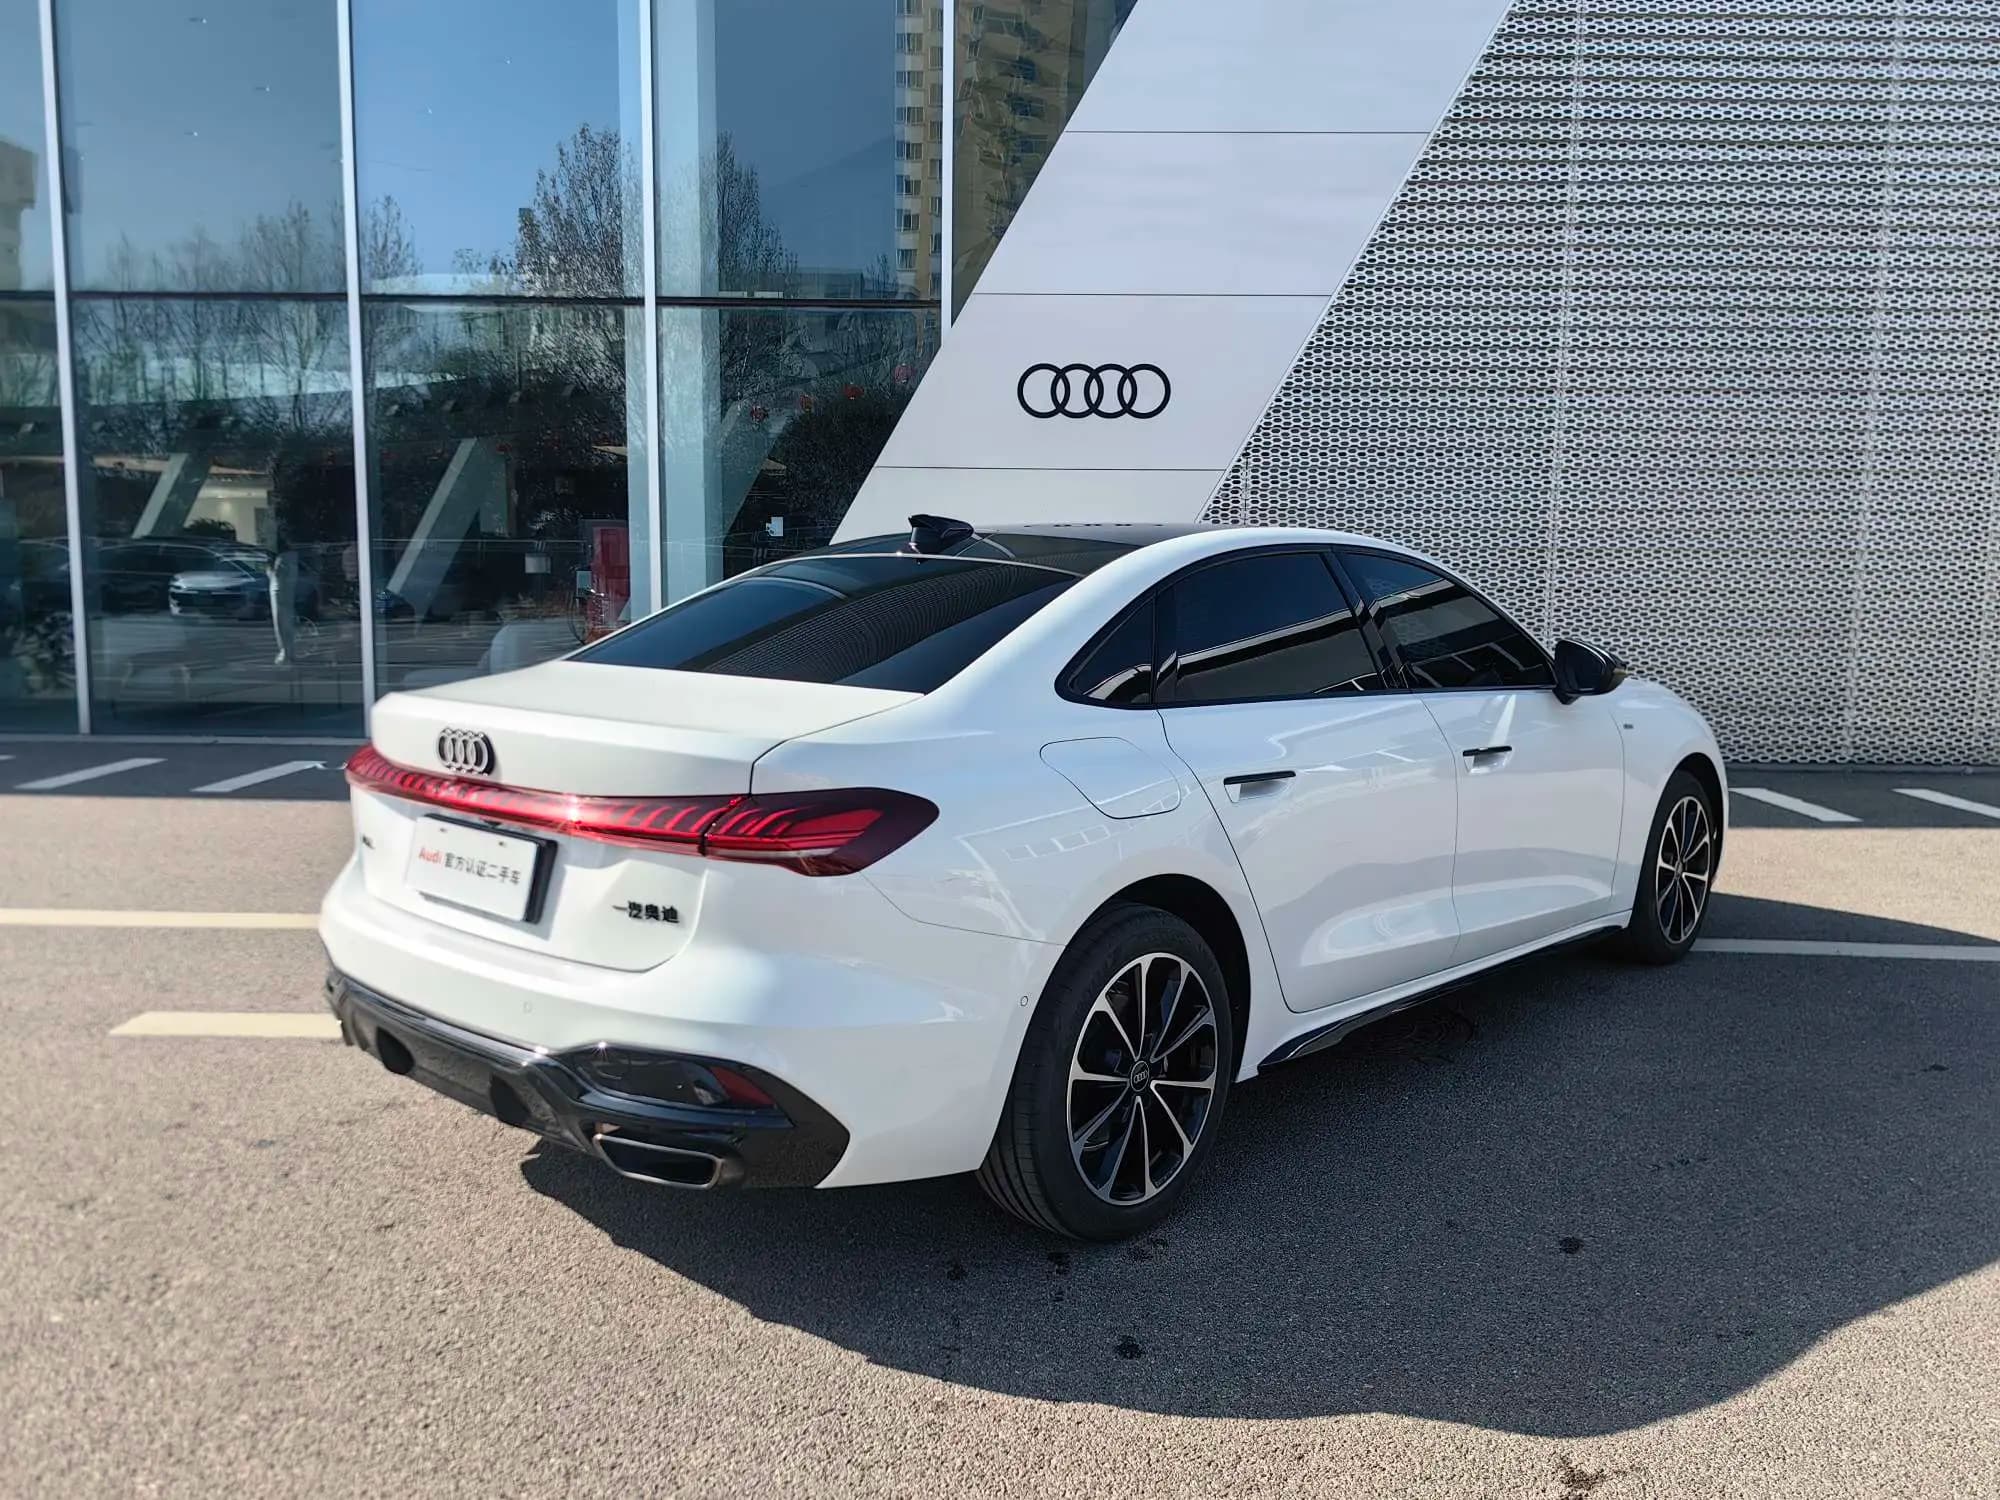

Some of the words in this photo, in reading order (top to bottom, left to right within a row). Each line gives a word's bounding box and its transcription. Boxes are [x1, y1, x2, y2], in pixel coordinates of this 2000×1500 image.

[418, 847, 443, 864] Audi
[444, 852, 521, 885] 官方认证二手车
[612, 900, 680, 924] 一汽奥迪
